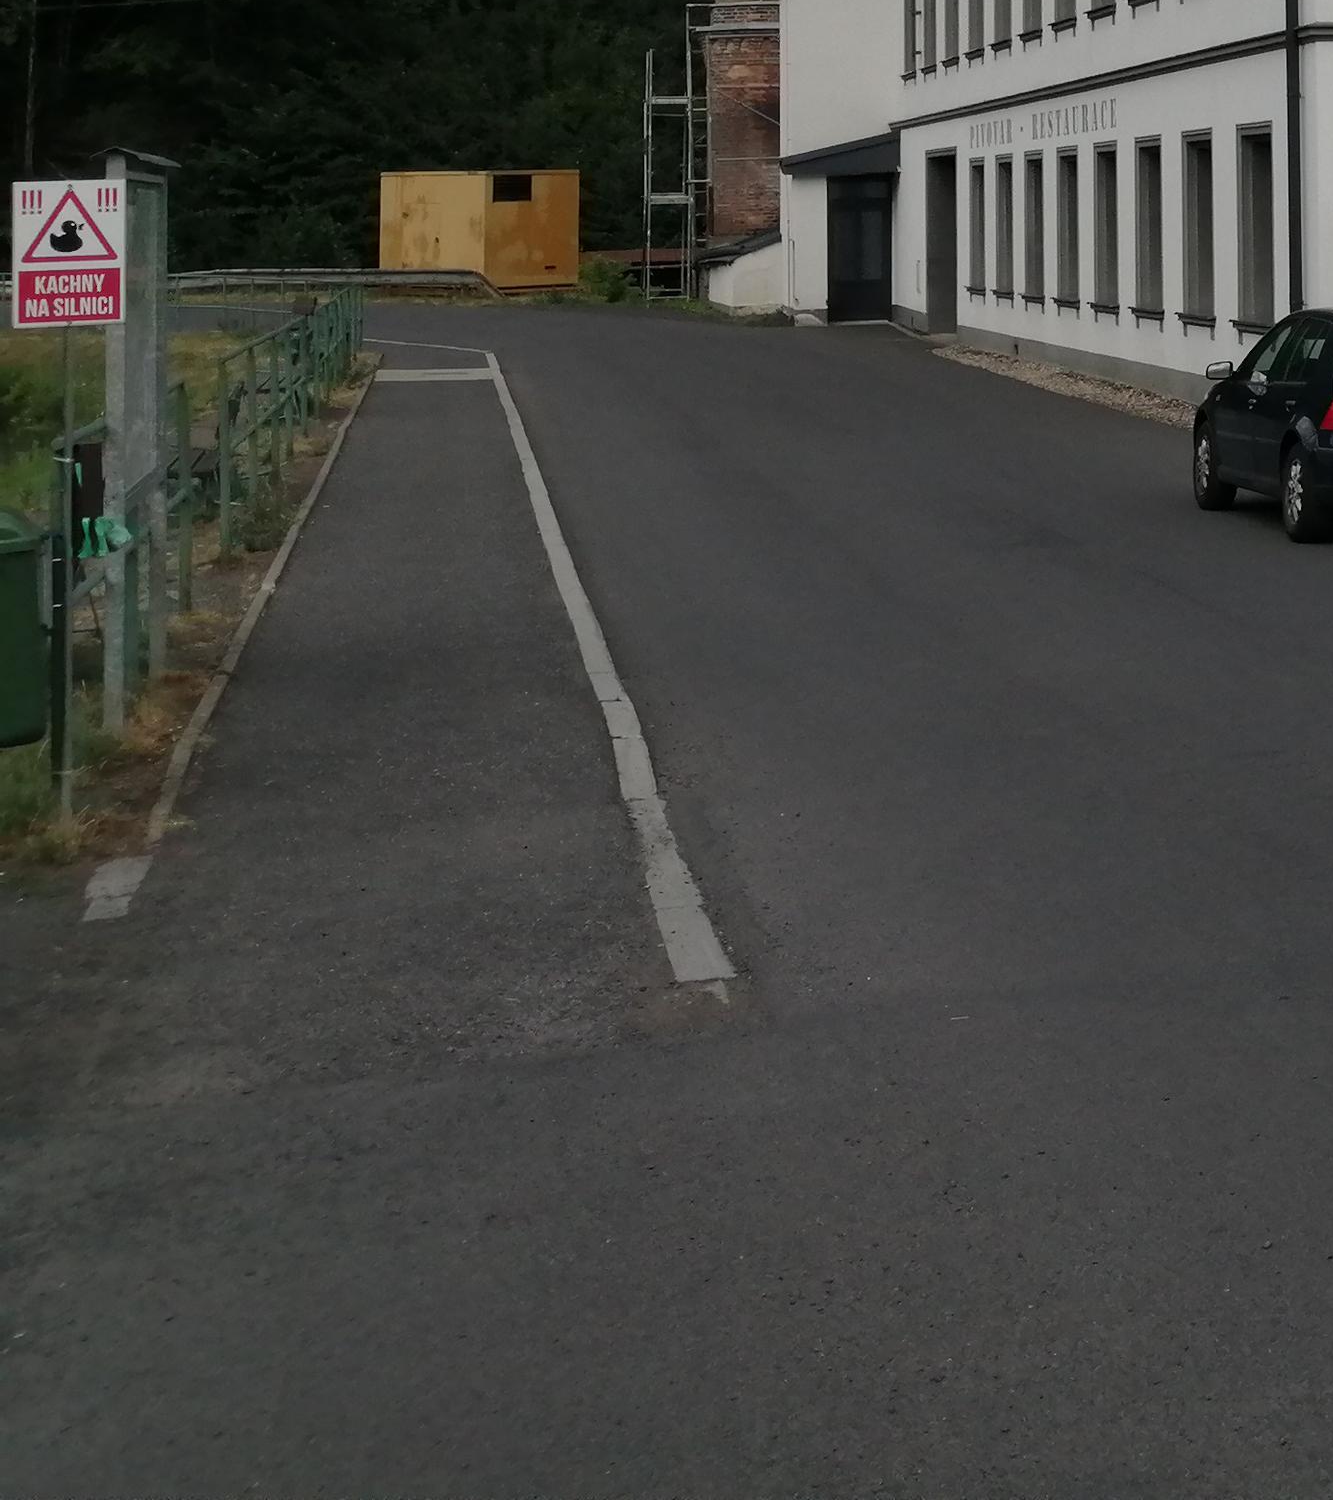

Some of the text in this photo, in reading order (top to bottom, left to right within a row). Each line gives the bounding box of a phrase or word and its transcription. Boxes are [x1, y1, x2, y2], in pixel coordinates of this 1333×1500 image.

[969, 98, 1117, 149] PIVOVAR RESTAURACE
[34, 273, 106, 295] KACHNY
[25, 295, 114, 318] NA SILNICI
